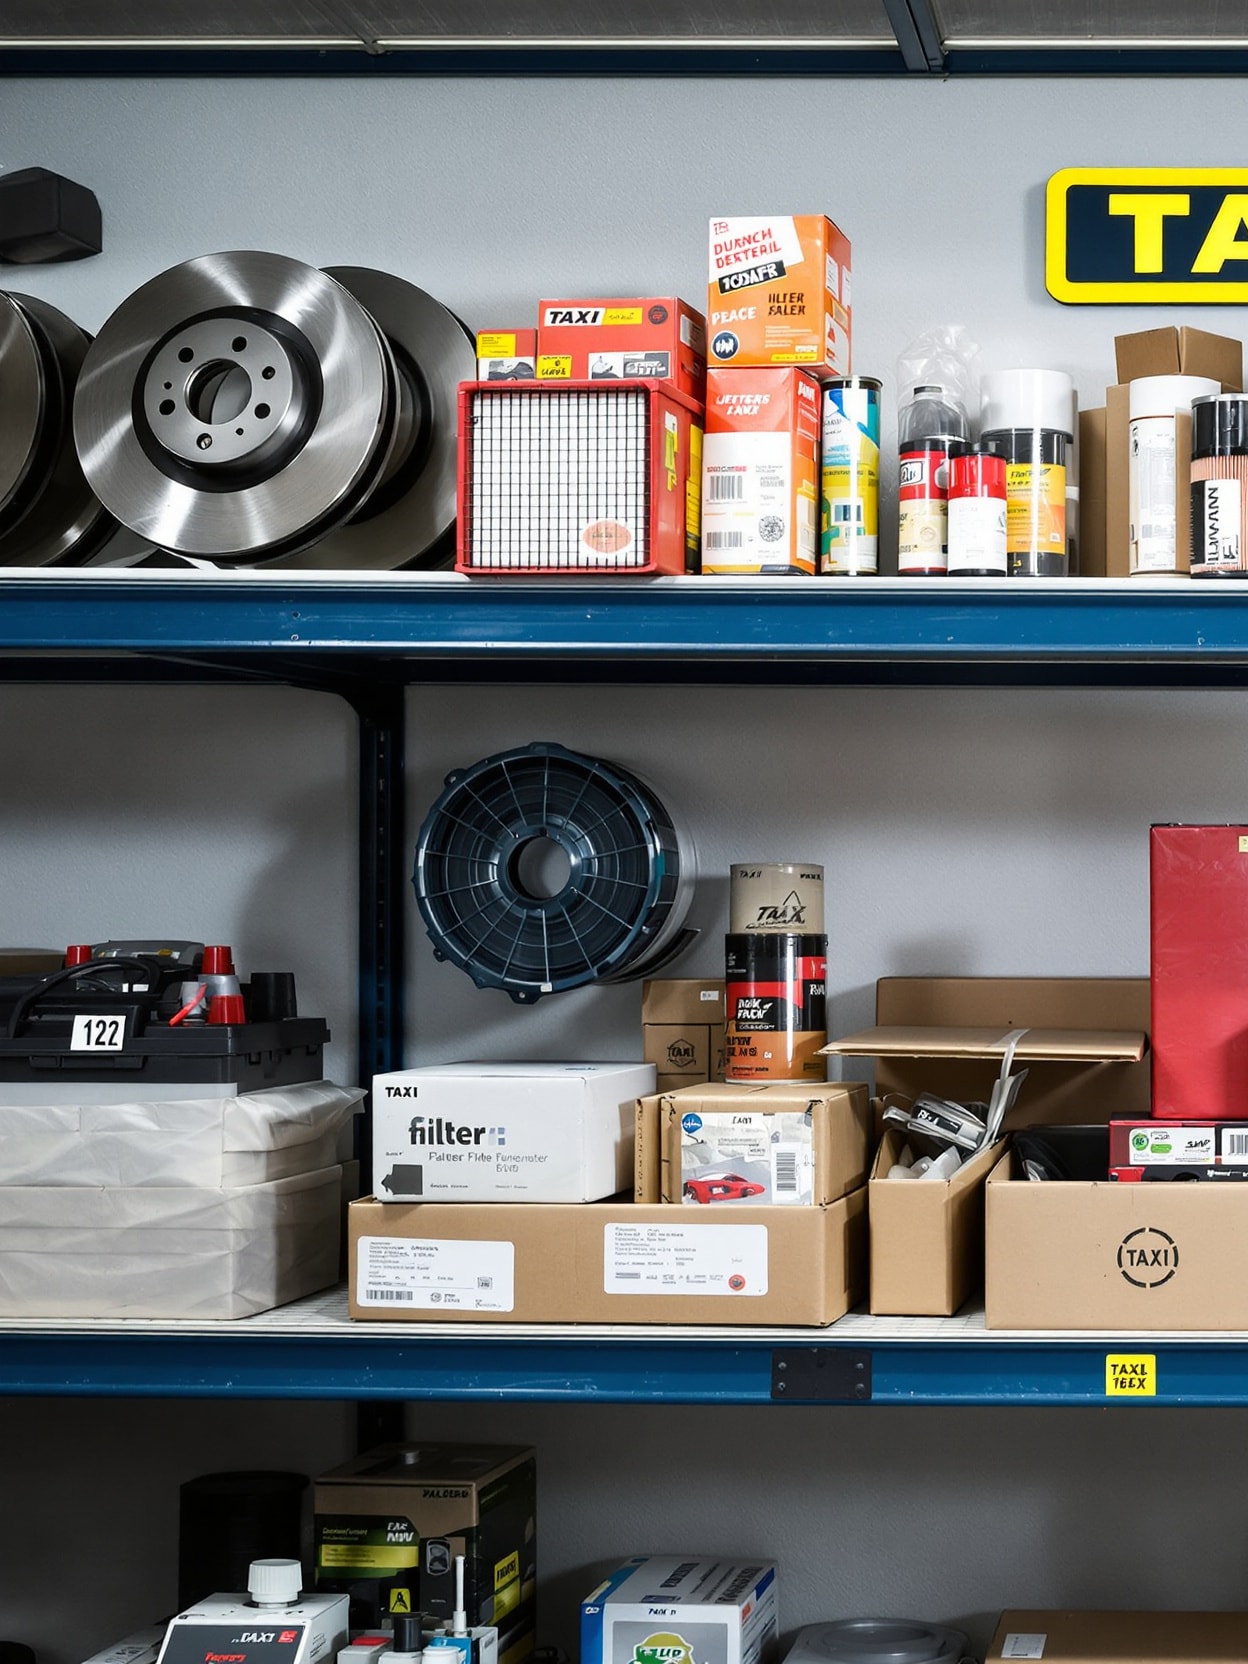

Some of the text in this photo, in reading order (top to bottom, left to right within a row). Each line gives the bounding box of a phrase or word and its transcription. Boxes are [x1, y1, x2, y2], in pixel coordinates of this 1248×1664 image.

[549, 311, 600, 324] TAXI
[711, 306, 756, 325] PEACE
[83, 1019, 118, 1046] 122
[385, 1087, 418, 1098] TAXI
[1126, 1250, 1169, 1267] TAXI
